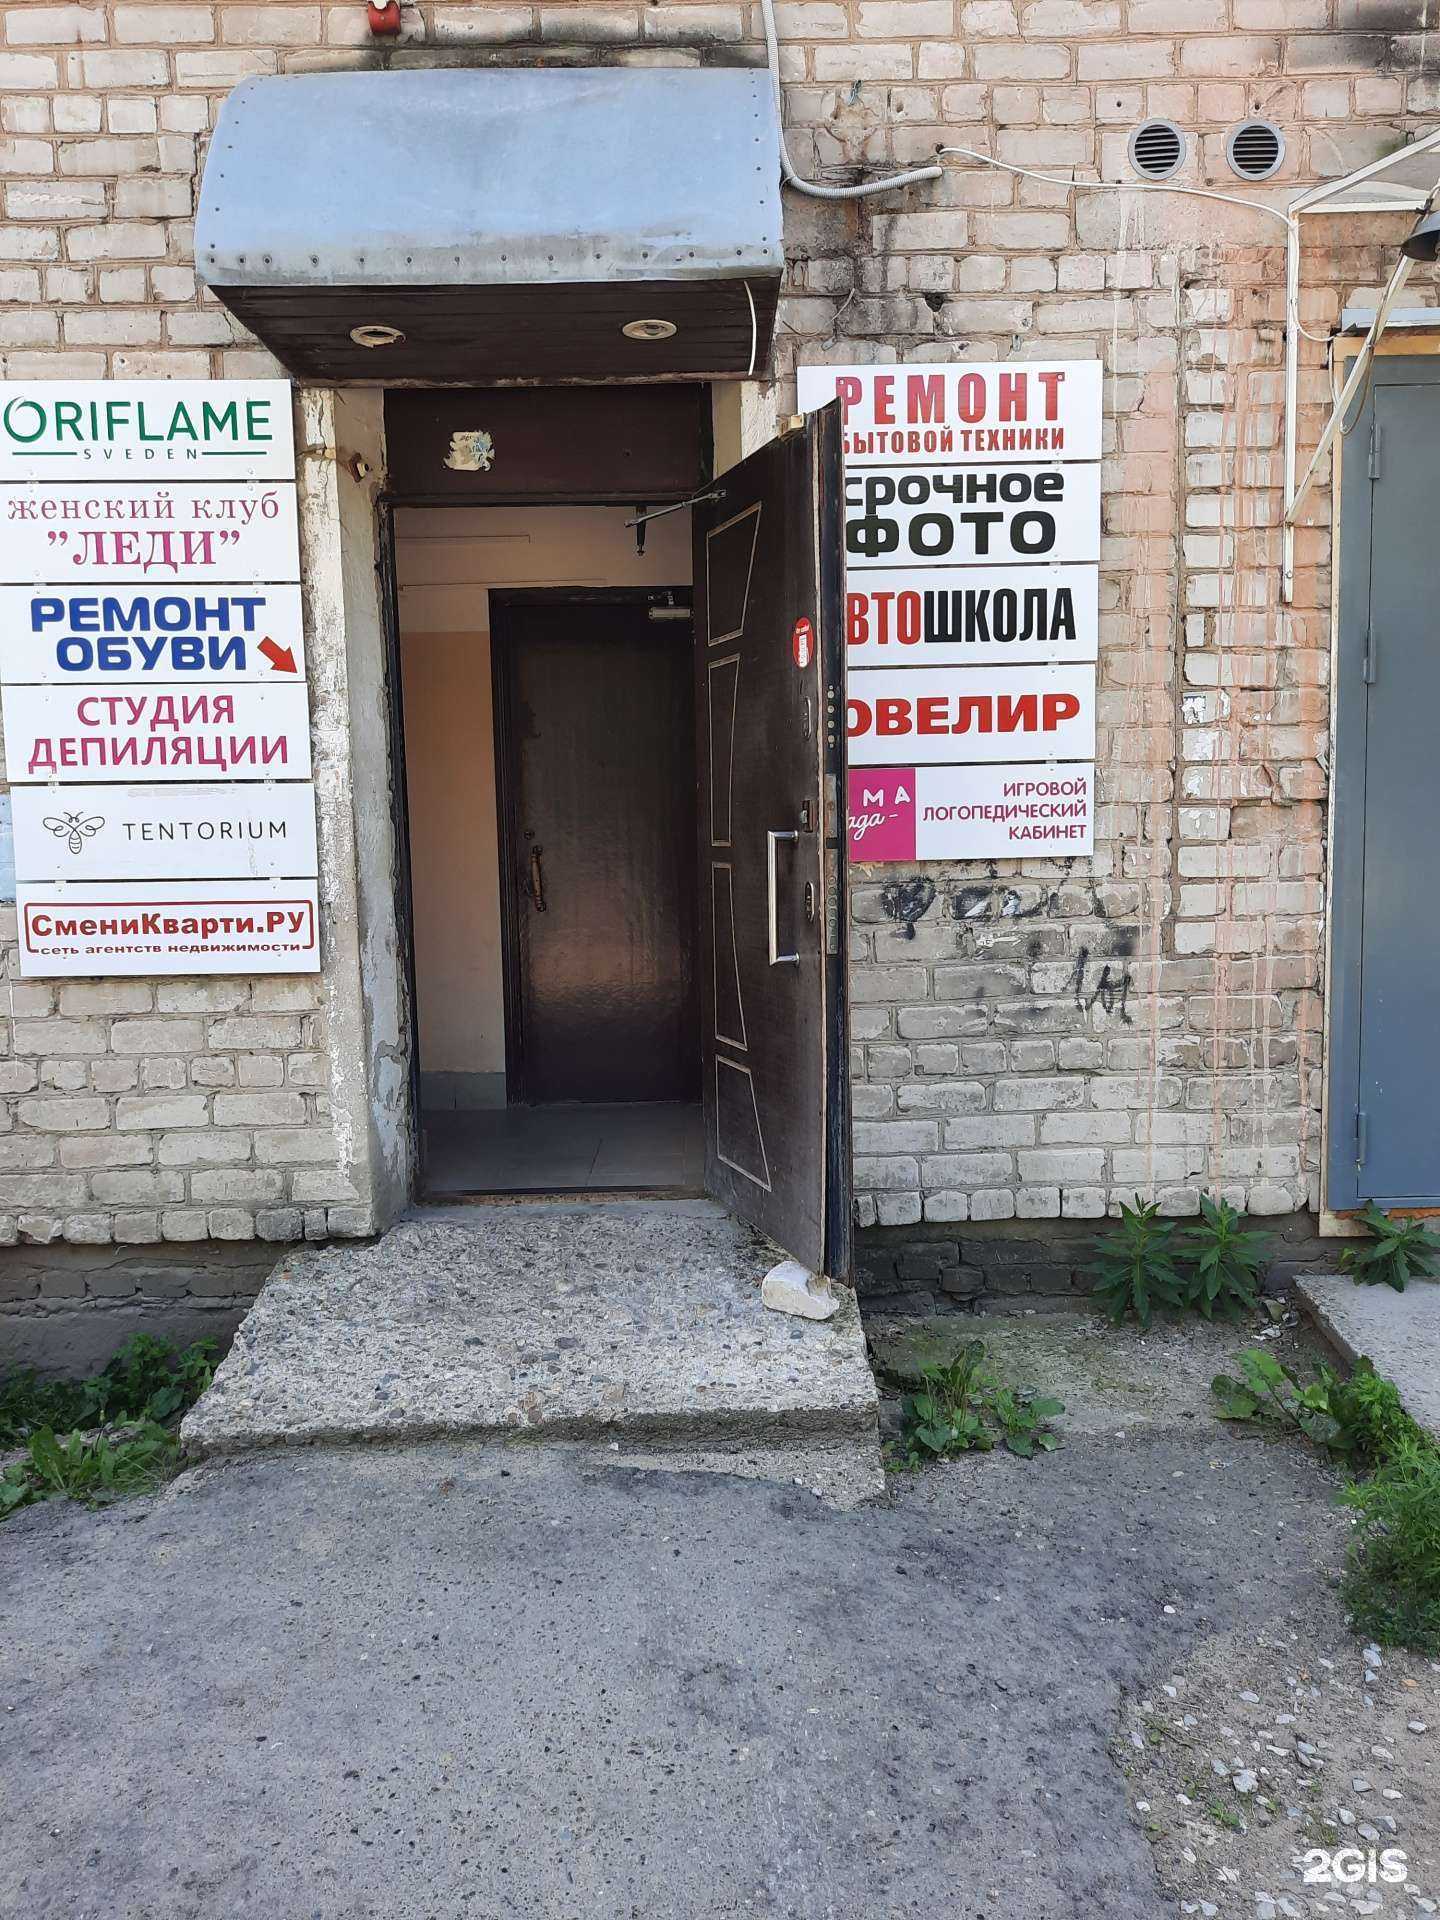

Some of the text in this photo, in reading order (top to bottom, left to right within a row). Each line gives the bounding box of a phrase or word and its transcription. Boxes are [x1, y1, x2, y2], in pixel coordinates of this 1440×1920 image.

[836, 372, 1065, 425] РЕМОНТ
[4, 396, 273, 443] ORIFLAME
[83, 448, 197, 460] SVEDEN
[960, 427, 1064, 452] ТЕХНИКИ
[8, 490, 279, 525] женский клуб
[846, 510, 1056, 557] ФОТО
[30, 596, 266, 632] РЕМОНТ
[847, 587, 1076, 645] ВТОШКОЛА
[56, 635, 246, 671] ОБУВИ
[77, 694, 235, 732] СТУДИЯ
[28, 735, 288, 774] ДЕПИЛЯЦИИ
[1003, 777, 1087, 797] ИГРОВОЙ
[923, 799, 1087, 823] ЛОГОПЕДИЧЕСКИЙ
[122, 821, 287, 841] TENTORIUM
[1008, 825, 1087, 841] КАБИНЕТ
[40, 944, 300, 955] сеть агентств недвижимости
